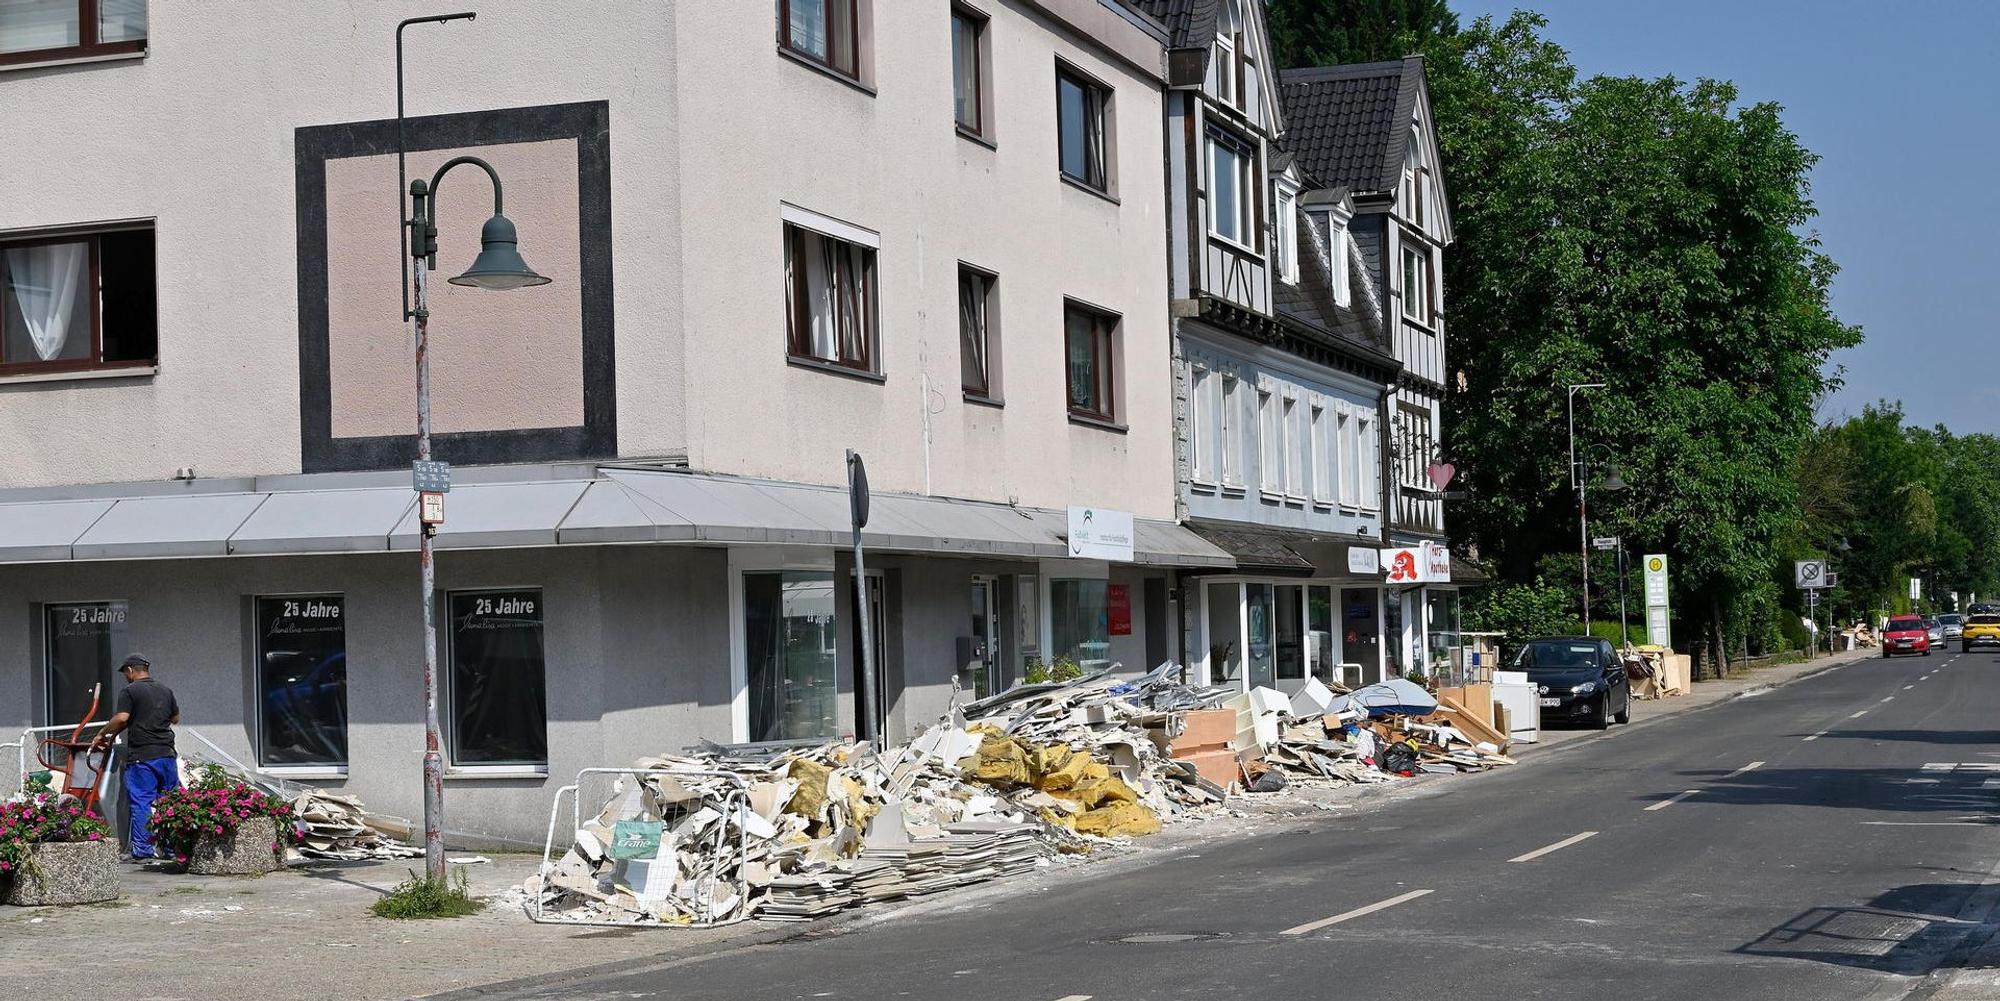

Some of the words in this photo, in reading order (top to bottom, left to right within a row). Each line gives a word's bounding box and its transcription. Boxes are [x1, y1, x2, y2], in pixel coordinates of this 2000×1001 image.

[1430, 560, 1448, 577] Apotheke
[283, 601, 299, 616] 25
[302, 601, 339, 617] Jahre
[476, 598, 491, 614] 25
[495, 597, 534, 614] Jahre
[72, 608, 87, 623] 25
[90, 607, 125, 622] Jahre
[617, 838, 651, 848] Crane
